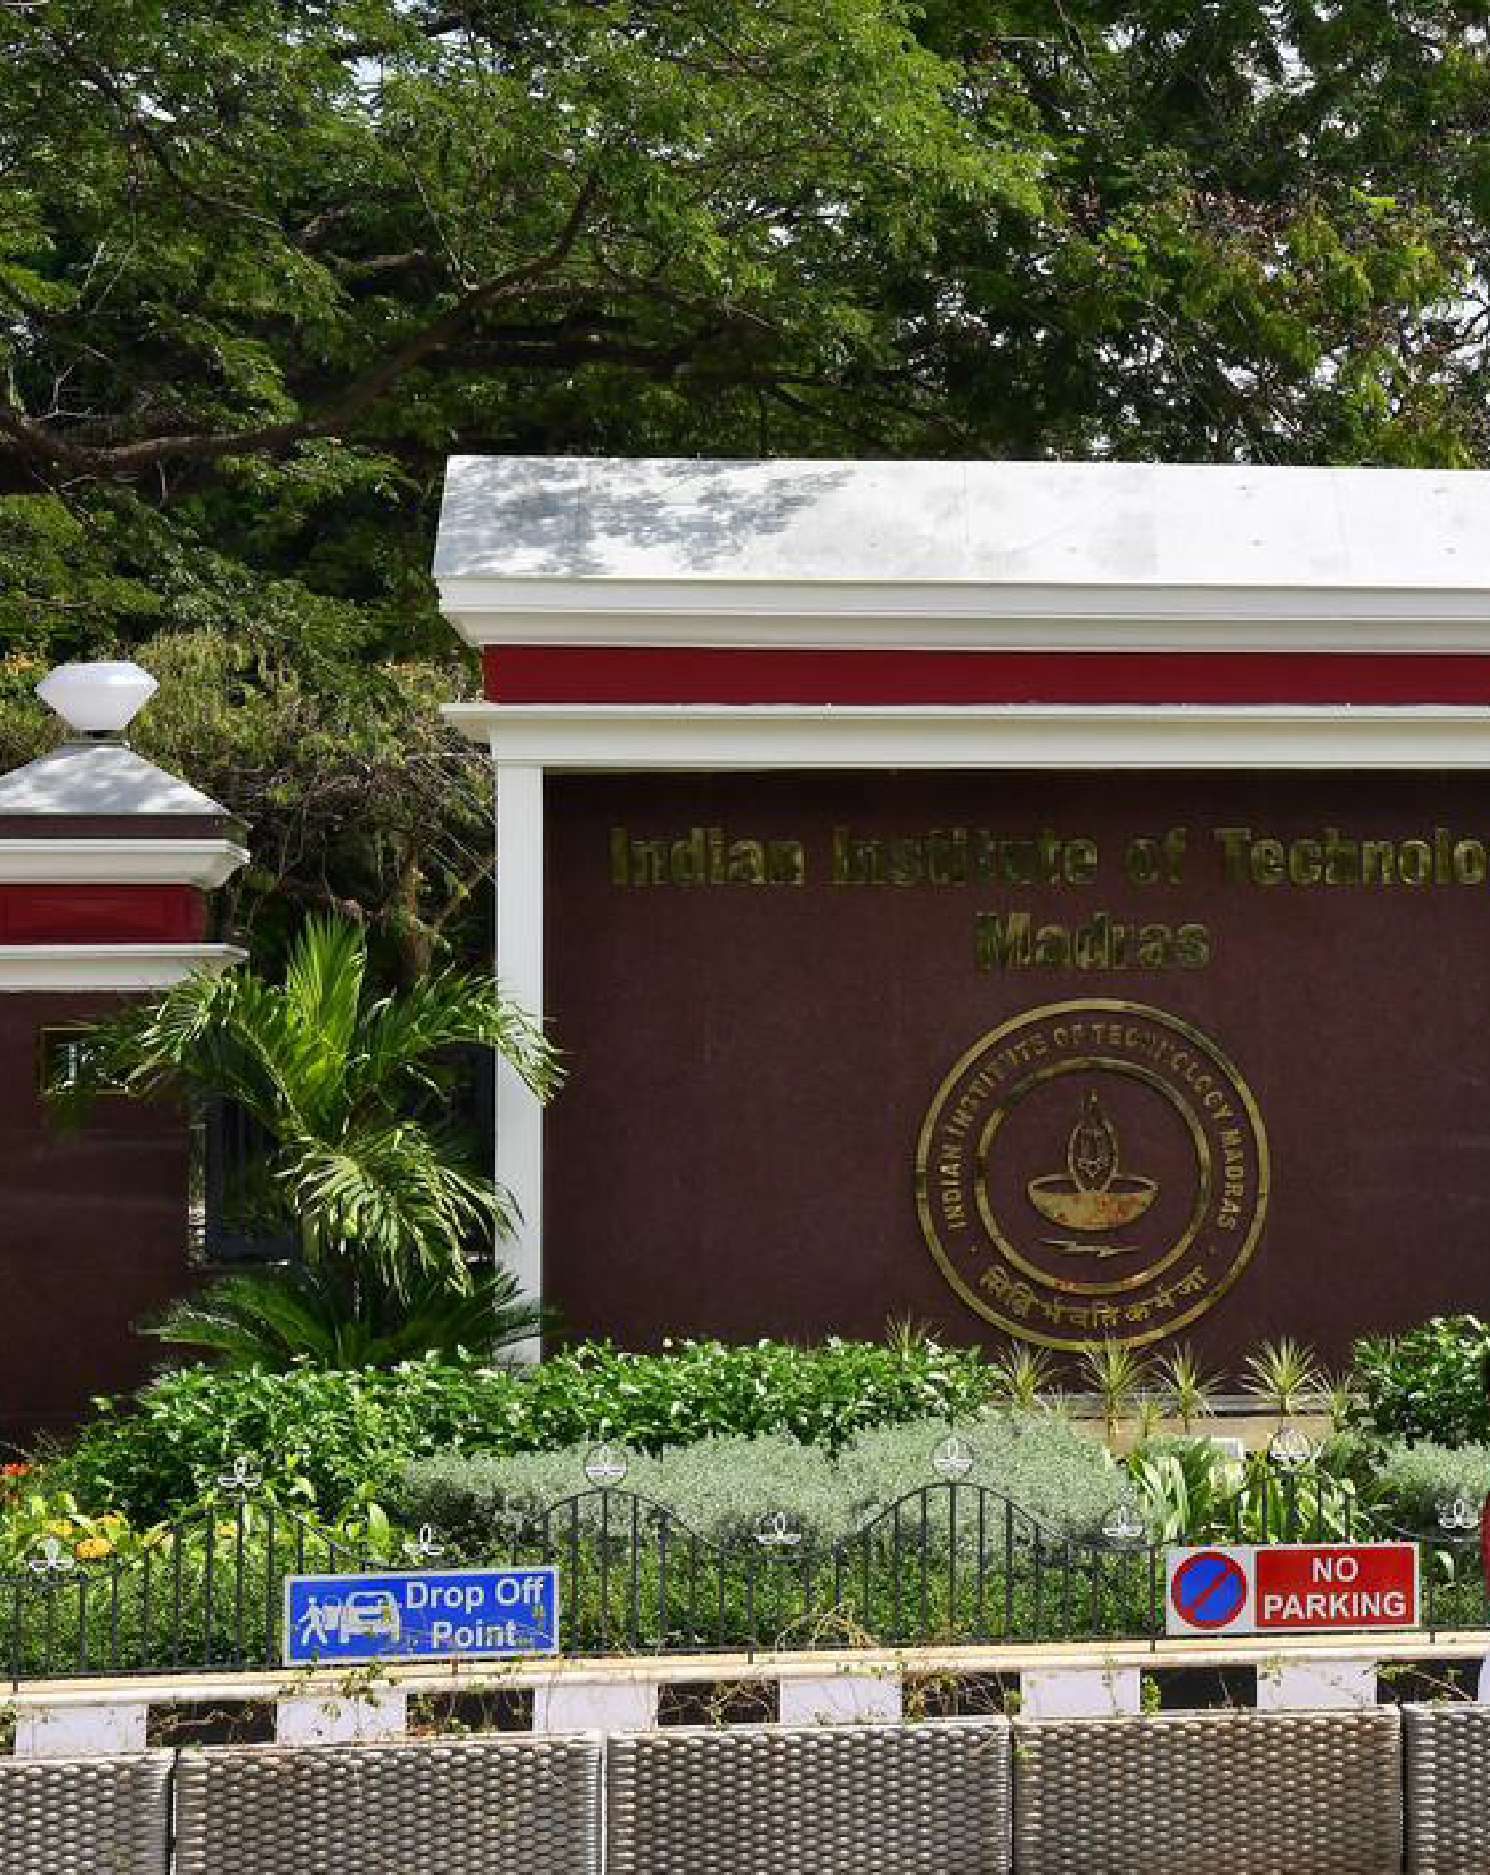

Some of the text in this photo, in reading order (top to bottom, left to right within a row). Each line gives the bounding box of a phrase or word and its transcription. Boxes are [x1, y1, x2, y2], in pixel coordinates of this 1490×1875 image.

[609, 826, 804, 886] Indian
[832, 826, 1098, 886] Institute
[1122, 827, 1188, 886] of
[973, 911, 1212, 970] Madras
[1312, 1557, 1359, 1583] NO
[406, 1575, 545, 1615] Drop Off
[1264, 1591, 1407, 1620] PARKING
[432, 1618, 517, 1649] Point
